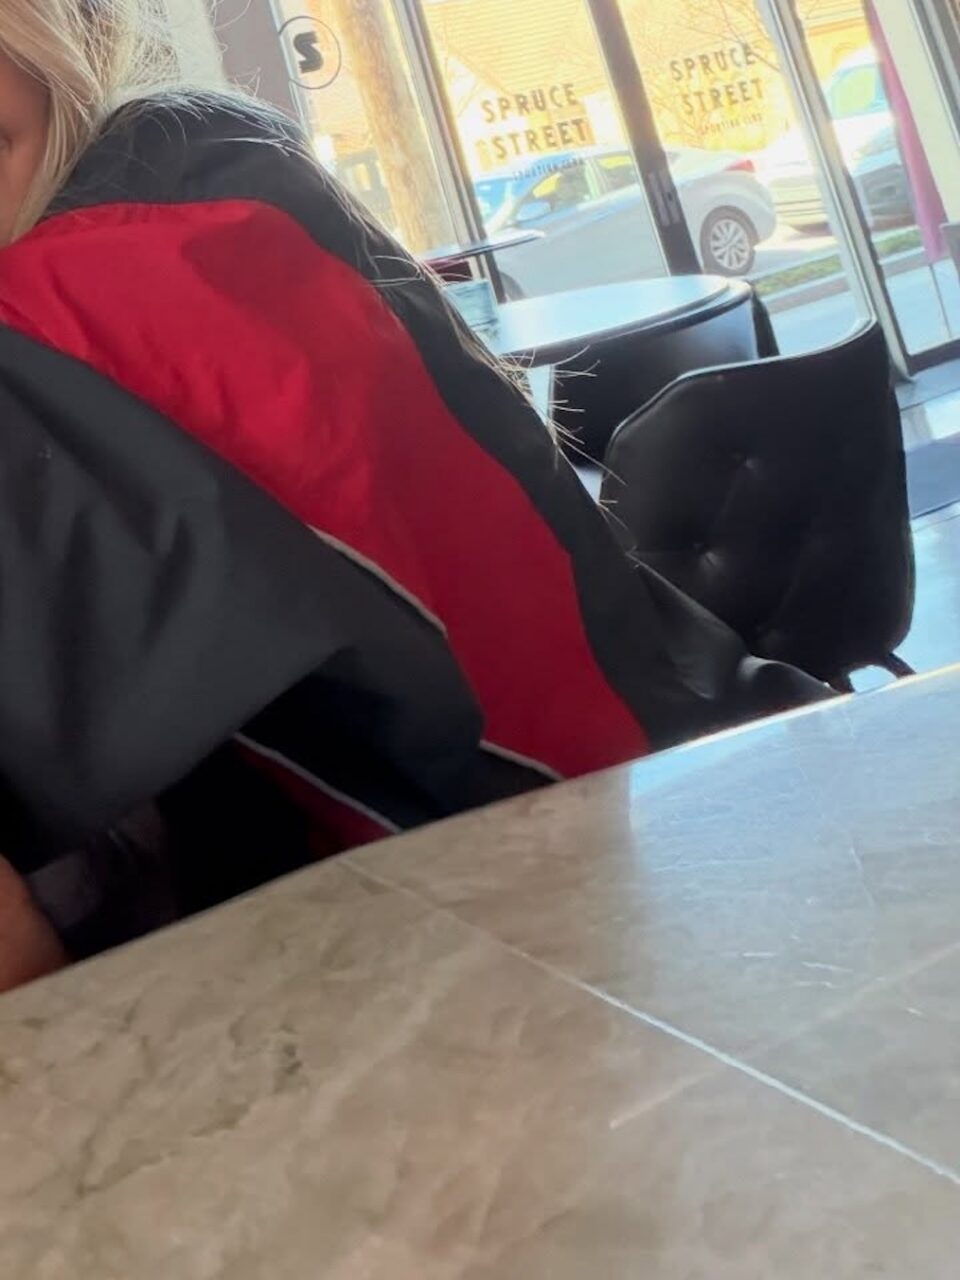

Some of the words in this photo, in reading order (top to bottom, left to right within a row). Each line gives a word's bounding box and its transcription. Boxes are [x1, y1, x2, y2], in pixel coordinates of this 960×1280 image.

[292, 30, 325, 75] S
[669, 42, 757, 82] SPRUCE
[480, 82, 580, 124] SPRUCE
[680, 77, 764, 116] STREET
[491, 117, 588, 160] STREET
